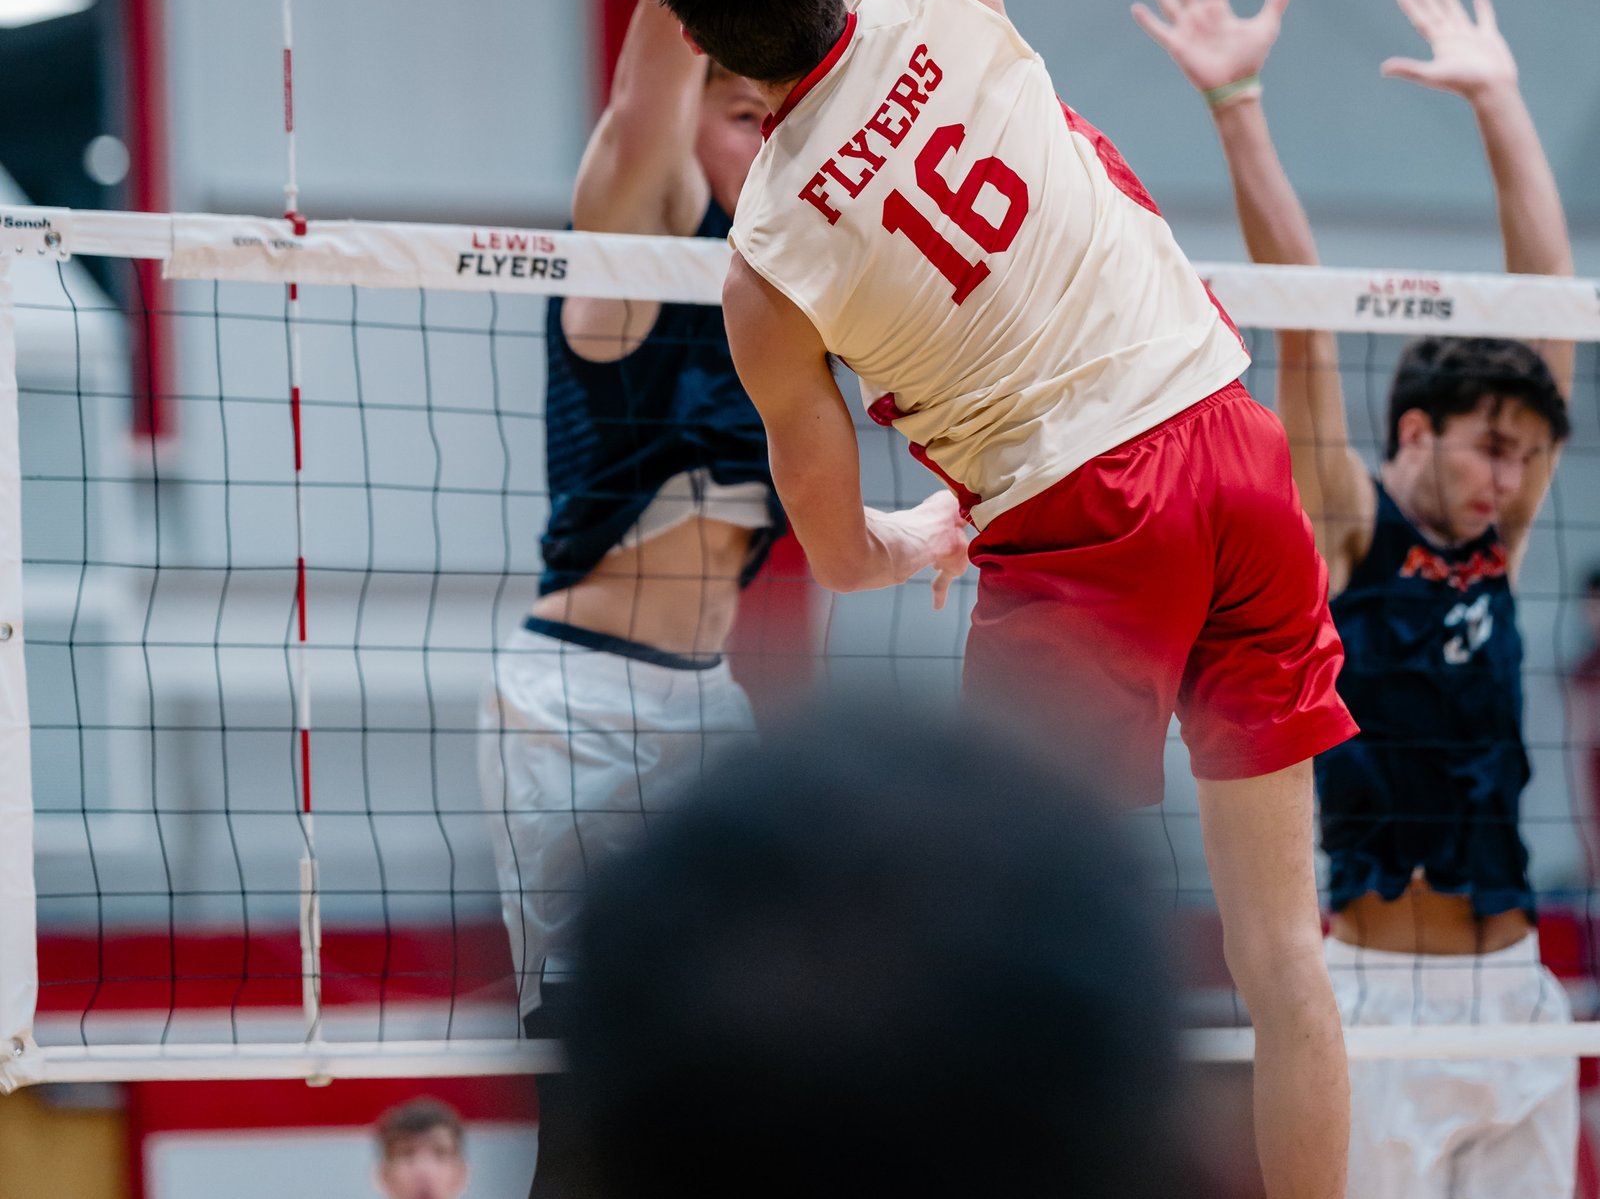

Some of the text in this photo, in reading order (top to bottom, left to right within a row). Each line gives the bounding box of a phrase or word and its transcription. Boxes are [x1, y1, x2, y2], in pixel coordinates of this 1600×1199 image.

[798, 43, 943, 226] FLYERS
[4, 215, 51, 229] Senoh
[881, 123, 1030, 307] 16
[471, 232, 555, 253] LEWIS
[457, 253, 568, 280] FLYERS
